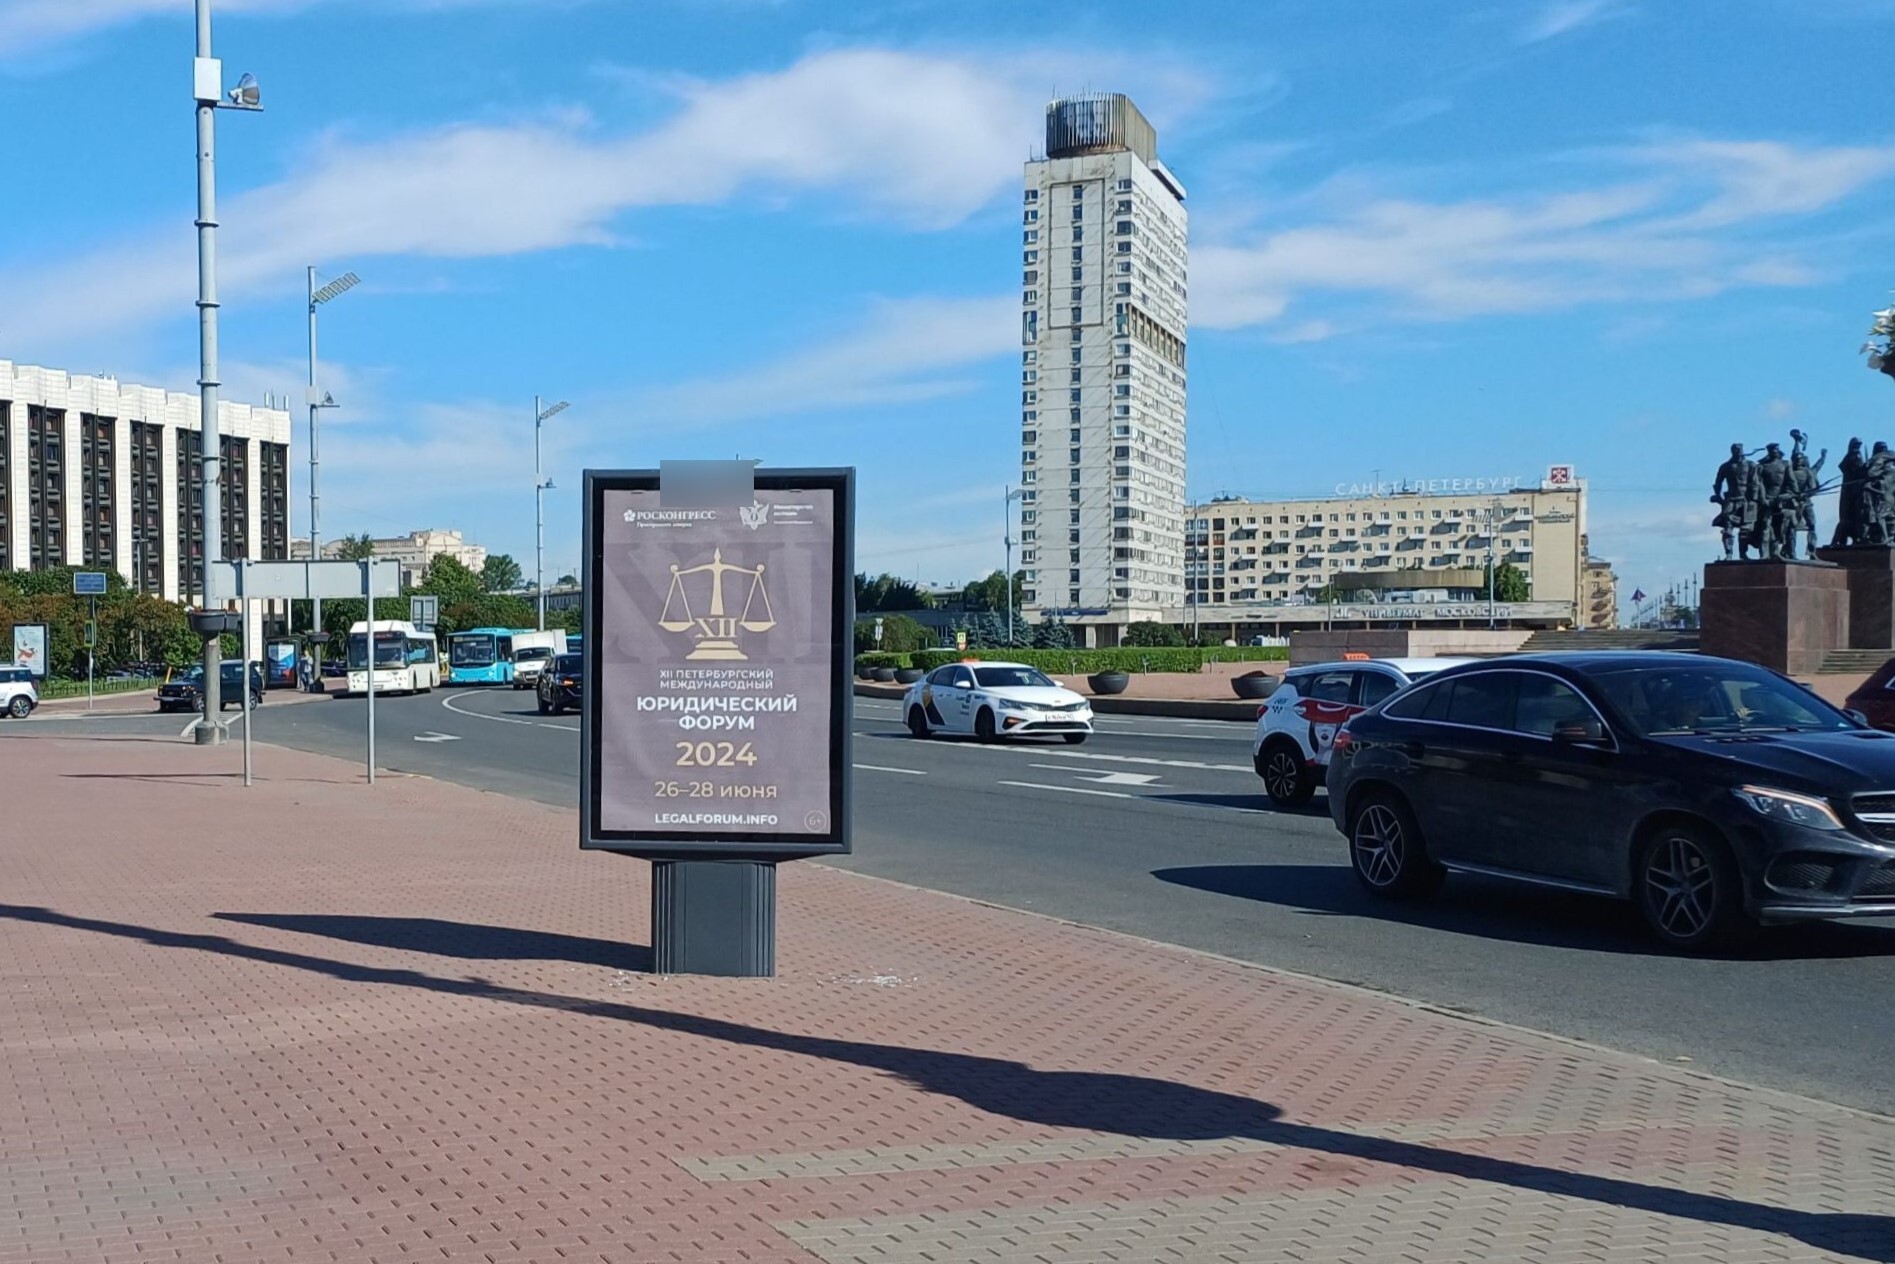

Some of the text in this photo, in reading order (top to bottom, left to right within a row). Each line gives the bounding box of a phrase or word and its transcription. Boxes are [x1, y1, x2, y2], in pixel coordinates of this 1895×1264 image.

[637, 510, 716, 520] РОСКОНГРЕСС
[695, 617, 739, 639] XII
[676, 668, 774, 679] ПЕТЕРБУРГСКИЙ
[660, 679, 773, 690] МЕЖДУНАРОДНЫЙ
[637, 693, 797, 713] ЮРИДИЧЕСКИЙ
[678, 714, 755, 730] ФОРУМ
[675, 741, 758, 767] 2024
[720, 785, 777, 798] июня
[655, 812, 778, 825] LEGALFORUM.INFO
